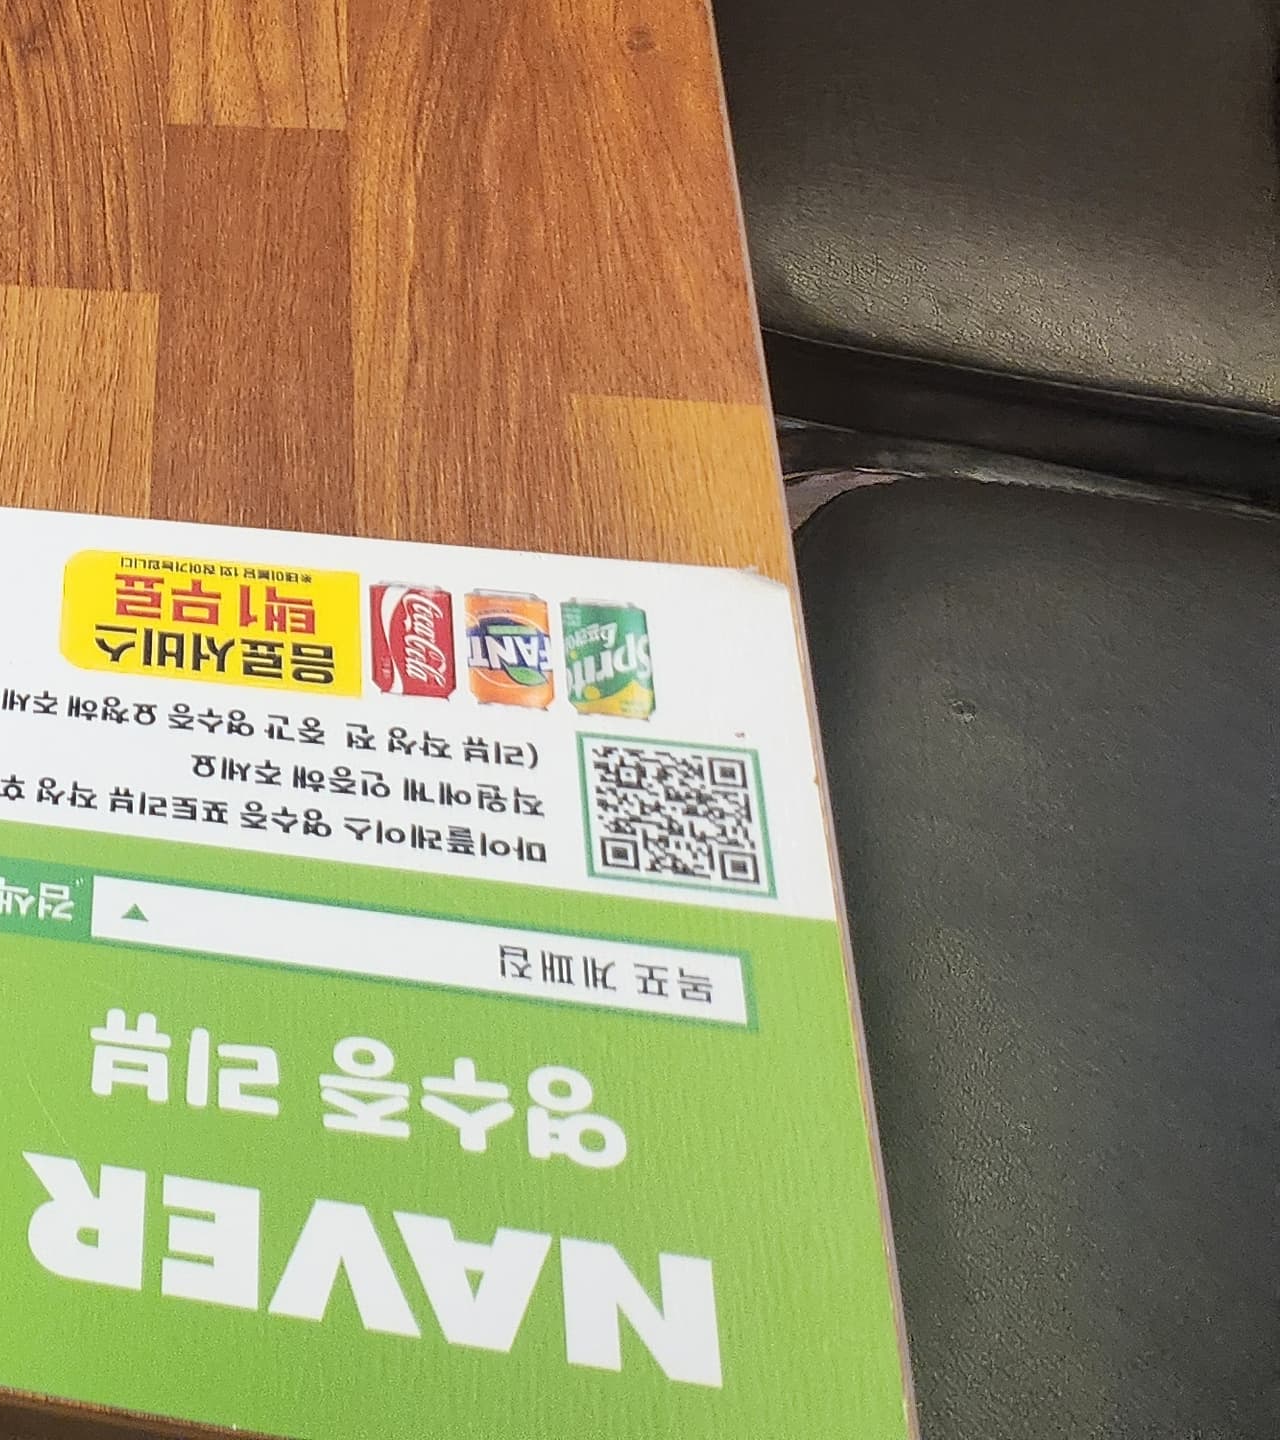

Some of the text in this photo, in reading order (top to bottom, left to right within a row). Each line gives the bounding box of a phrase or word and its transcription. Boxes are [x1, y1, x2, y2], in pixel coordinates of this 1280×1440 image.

[112, 572, 316, 635] 택1 무료
[92, 622, 335, 685] 음료서비스
[65, 694, 157, 726] 요청해
[166, 702, 254, 737] 영수증
[262, 713, 325, 745] 중간
[344, 721, 376, 751] 전
[385, 725, 452, 760] 작성
[460, 734, 539, 770] (리뷰
[34, 775, 98, 811] 작성
[107, 785, 228, 825] 포토리뷰
[190, 753, 544, 818] 직원에게 인증해 주세요
[238, 799, 332, 838] 영수증
[341, 814, 547, 864] 마이플레이스
[497, 943, 713, 1004] 목포 계패집
[88, 1006, 628, 1169] 영수증 리뷰
[20, 1149, 723, 1388] NAVER
